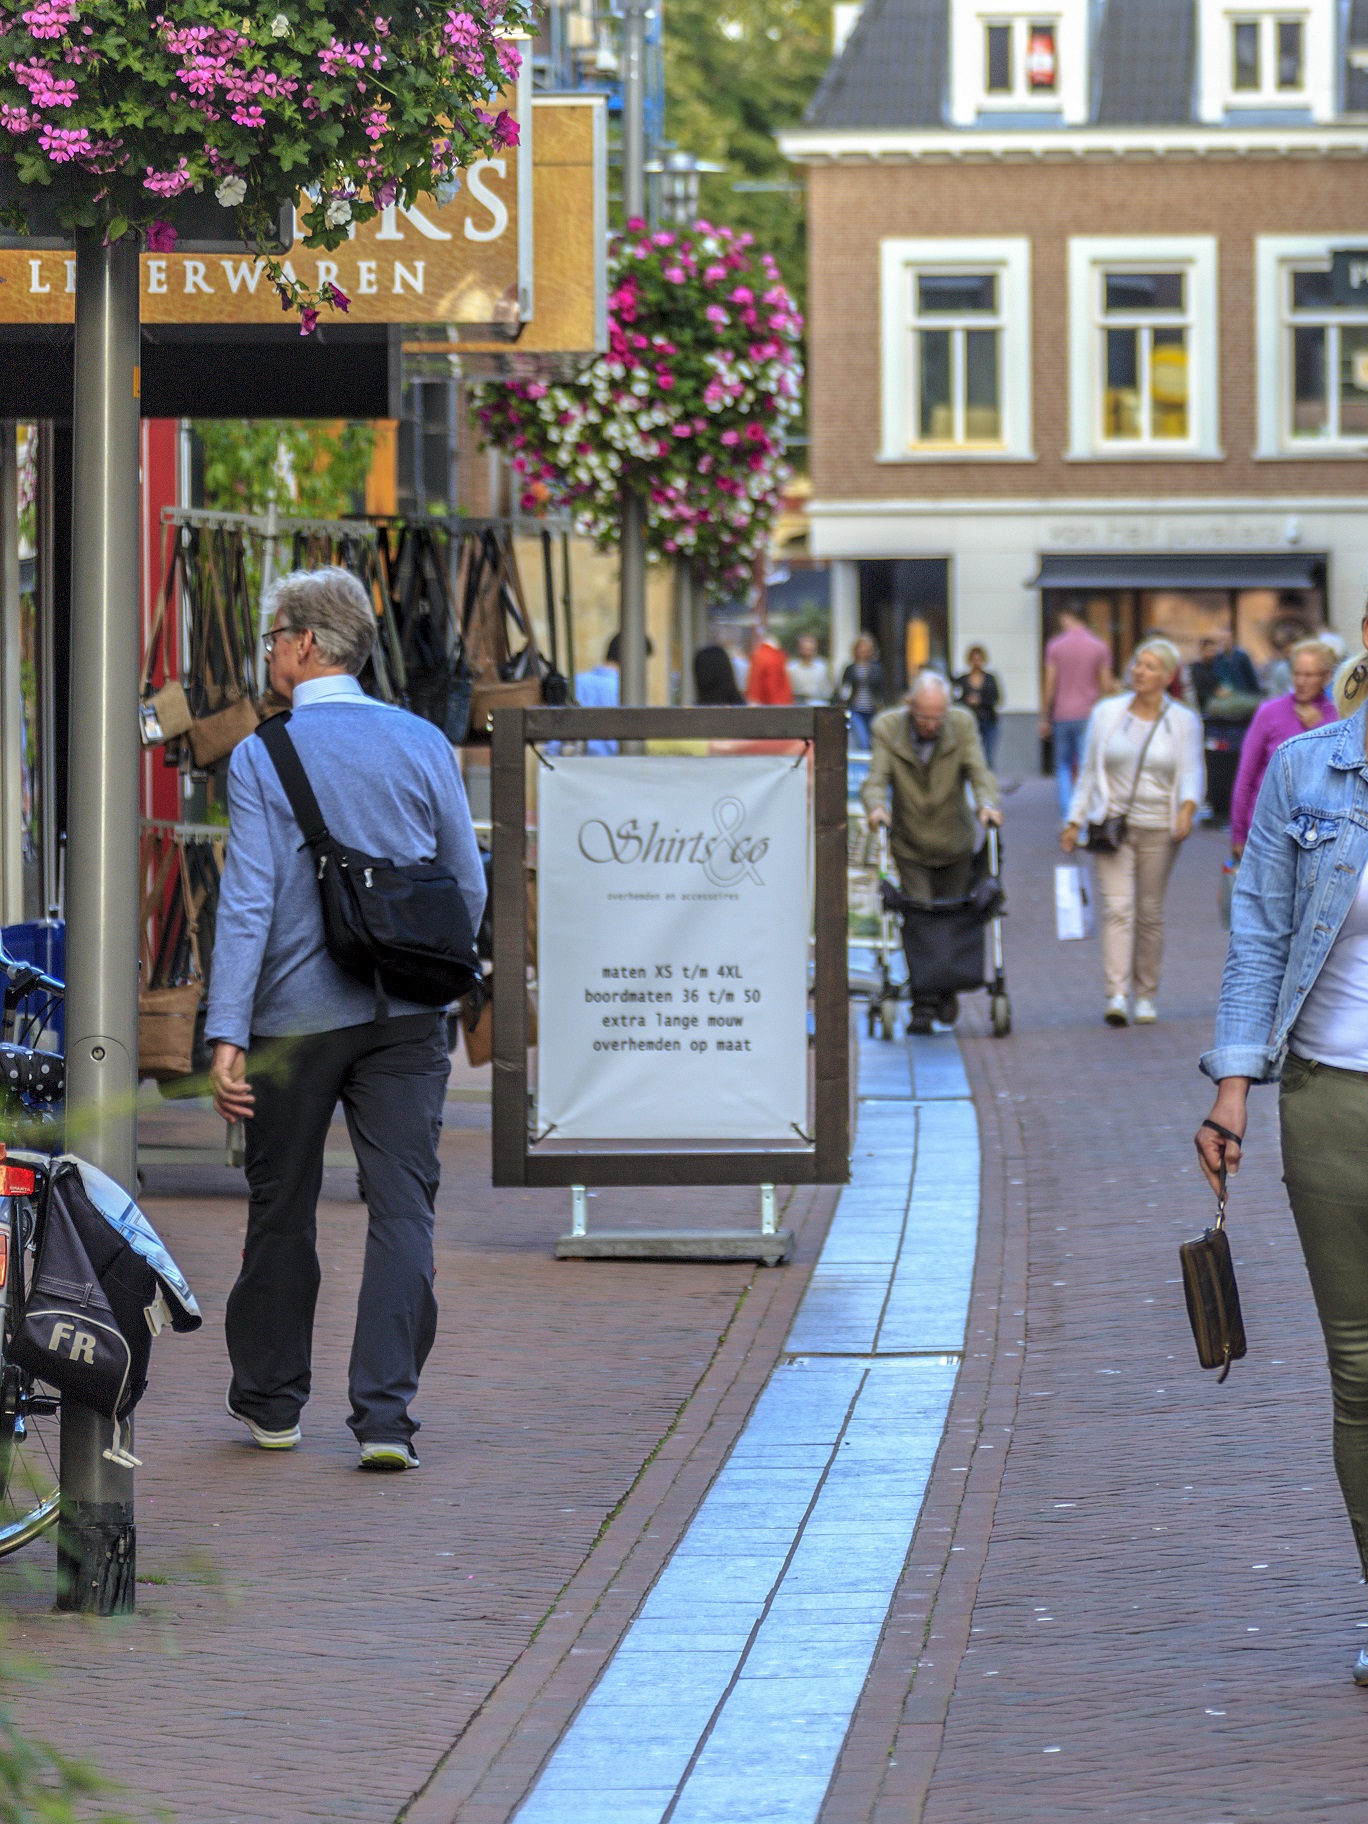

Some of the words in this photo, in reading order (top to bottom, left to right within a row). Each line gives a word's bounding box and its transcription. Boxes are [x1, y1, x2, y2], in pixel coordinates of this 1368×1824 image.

[28, 259, 427, 294] LEERWAREN
[606, 892, 660, 901] overhemden
[665, 893, 676, 901] en
[681, 892, 740, 901] accessoires
[602, 966, 646, 979] maten
[655, 965, 673, 979] XS
[682, 965, 708, 980] t/m
[717, 965, 743, 979] 4XL
[585, 989, 673, 1003] boordmaten
[682, 989, 699, 1003] 36
[709, 989, 735, 1004] t/m
[744, 989, 761, 1003] 50
[602, 1014, 646, 1027] extra
[656, 1012, 698, 1030] lange
[708, 1015, 743, 1027] mouw
[593, 1037, 681, 1051] overhemden
[690, 1039, 708, 1053] op
[716, 1038, 751, 1051] maat
[48, 1322, 96, 1365] FR
